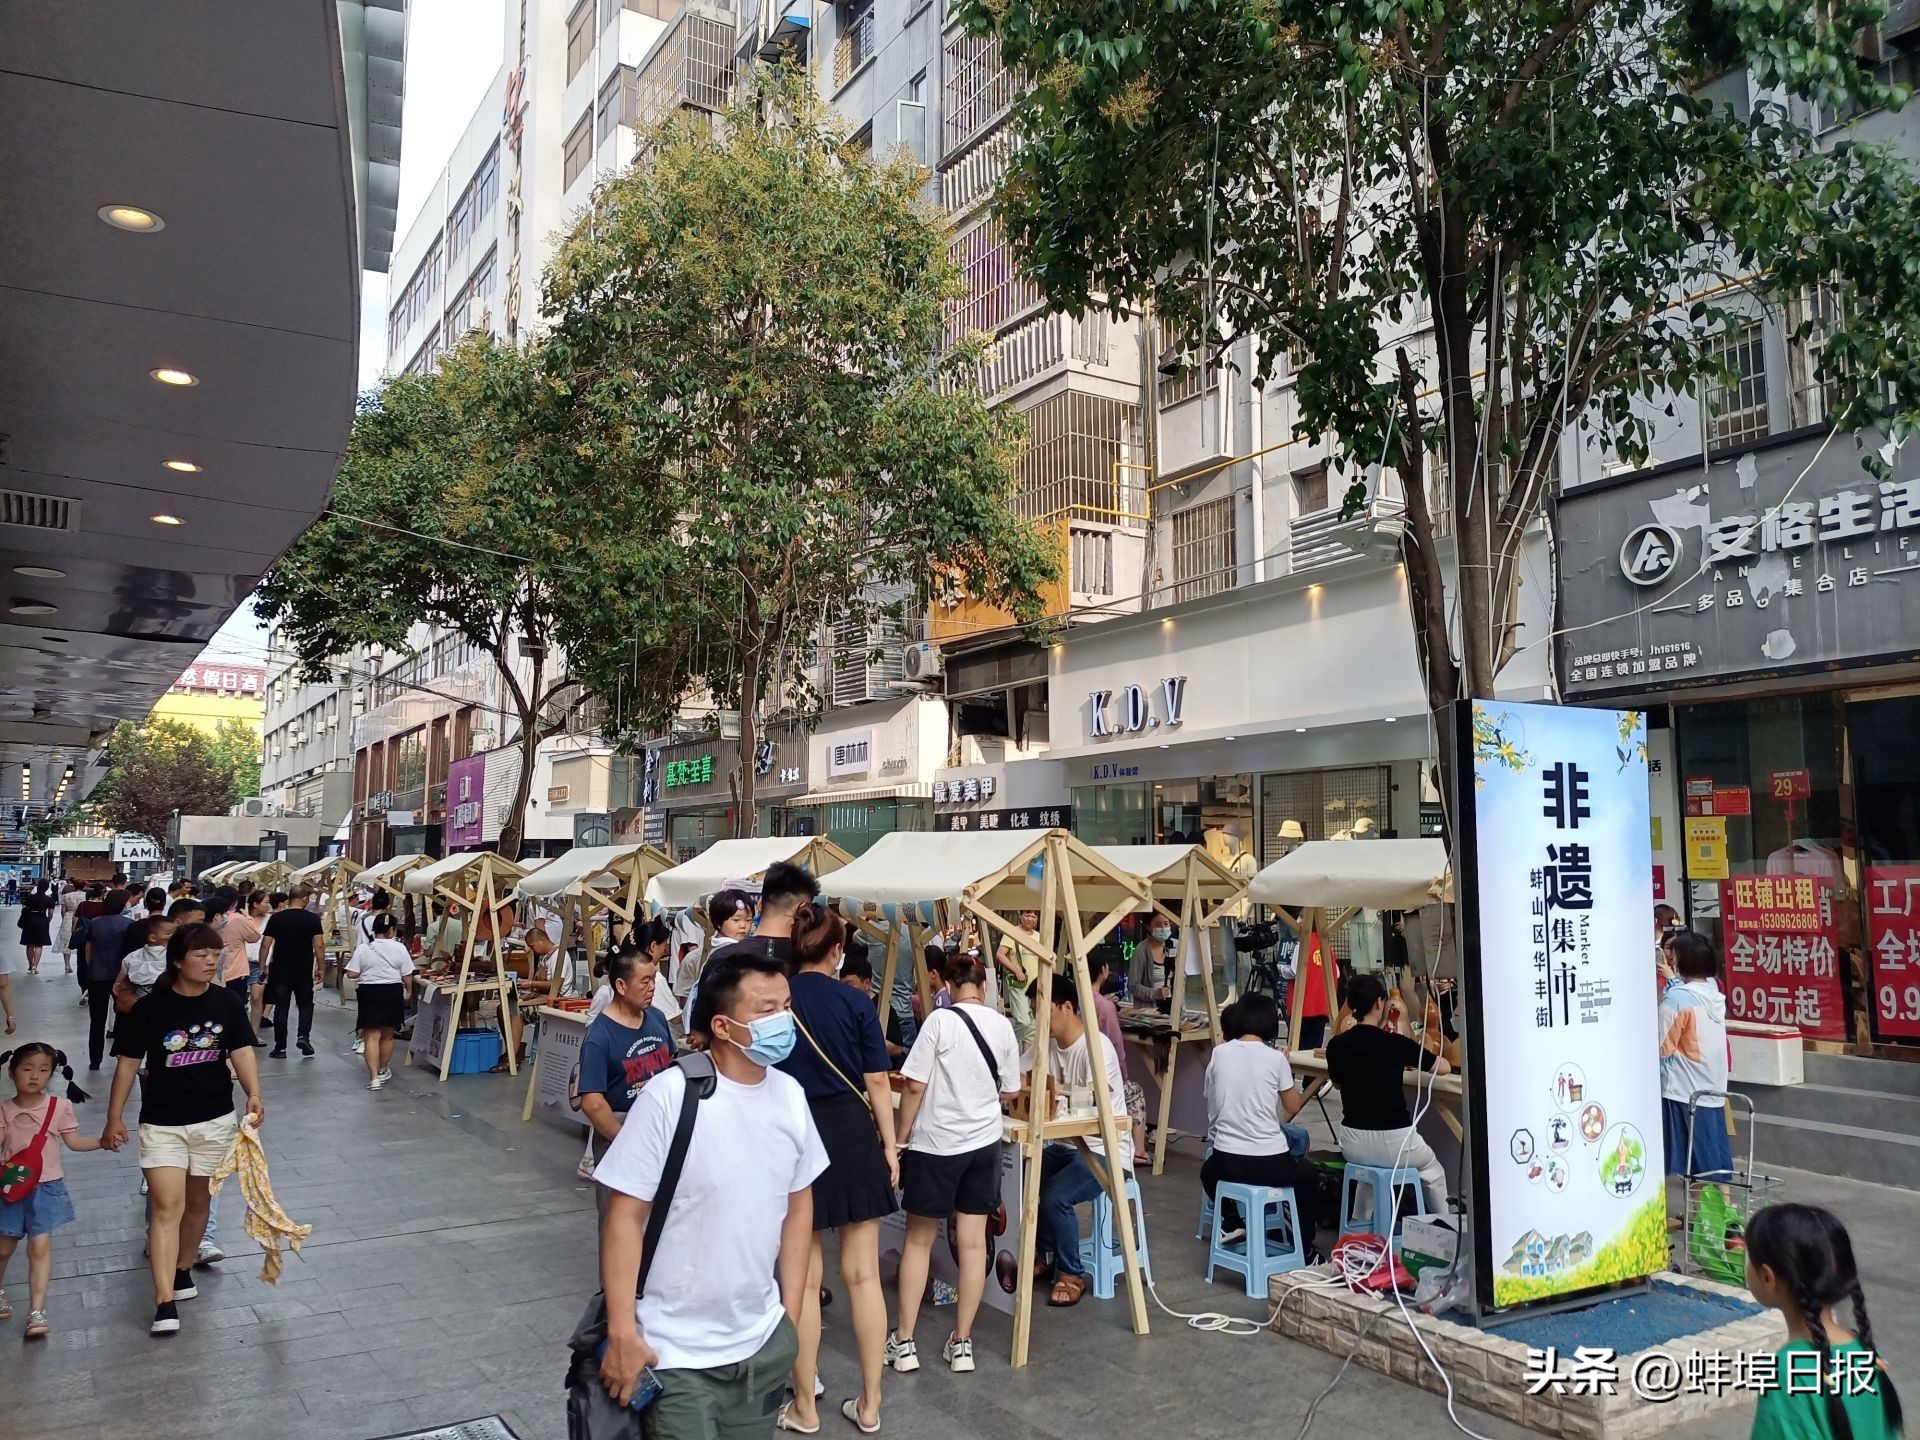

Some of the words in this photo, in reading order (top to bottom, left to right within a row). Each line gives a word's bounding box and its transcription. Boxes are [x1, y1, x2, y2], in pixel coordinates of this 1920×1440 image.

[1706, 480, 1920, 563] 安格生活
[1570, 652, 1697, 682] 全国连锁加盟品牌
[933, 777, 995, 804] 最爱美甲
[1774, 778, 1793, 797] 29
[1010, 812, 1030, 828] 化妆
[1039, 811, 1061, 827] 纹绣
[1542, 762, 1593, 910] 非遗
[1735, 877, 1816, 910] 旺铺出租
[1760, 912, 1818, 929] 15309626806
[1529, 868, 1549, 1029] 蚌山区华丰街
[1579, 914, 1591, 966] Market
[1730, 934, 1835, 977] 全场特价
[1551, 917, 1577, 1026] 集市
[1731, 986, 1822, 1028] 9.9元起
[168, 1049, 220, 1067] BILLIE
